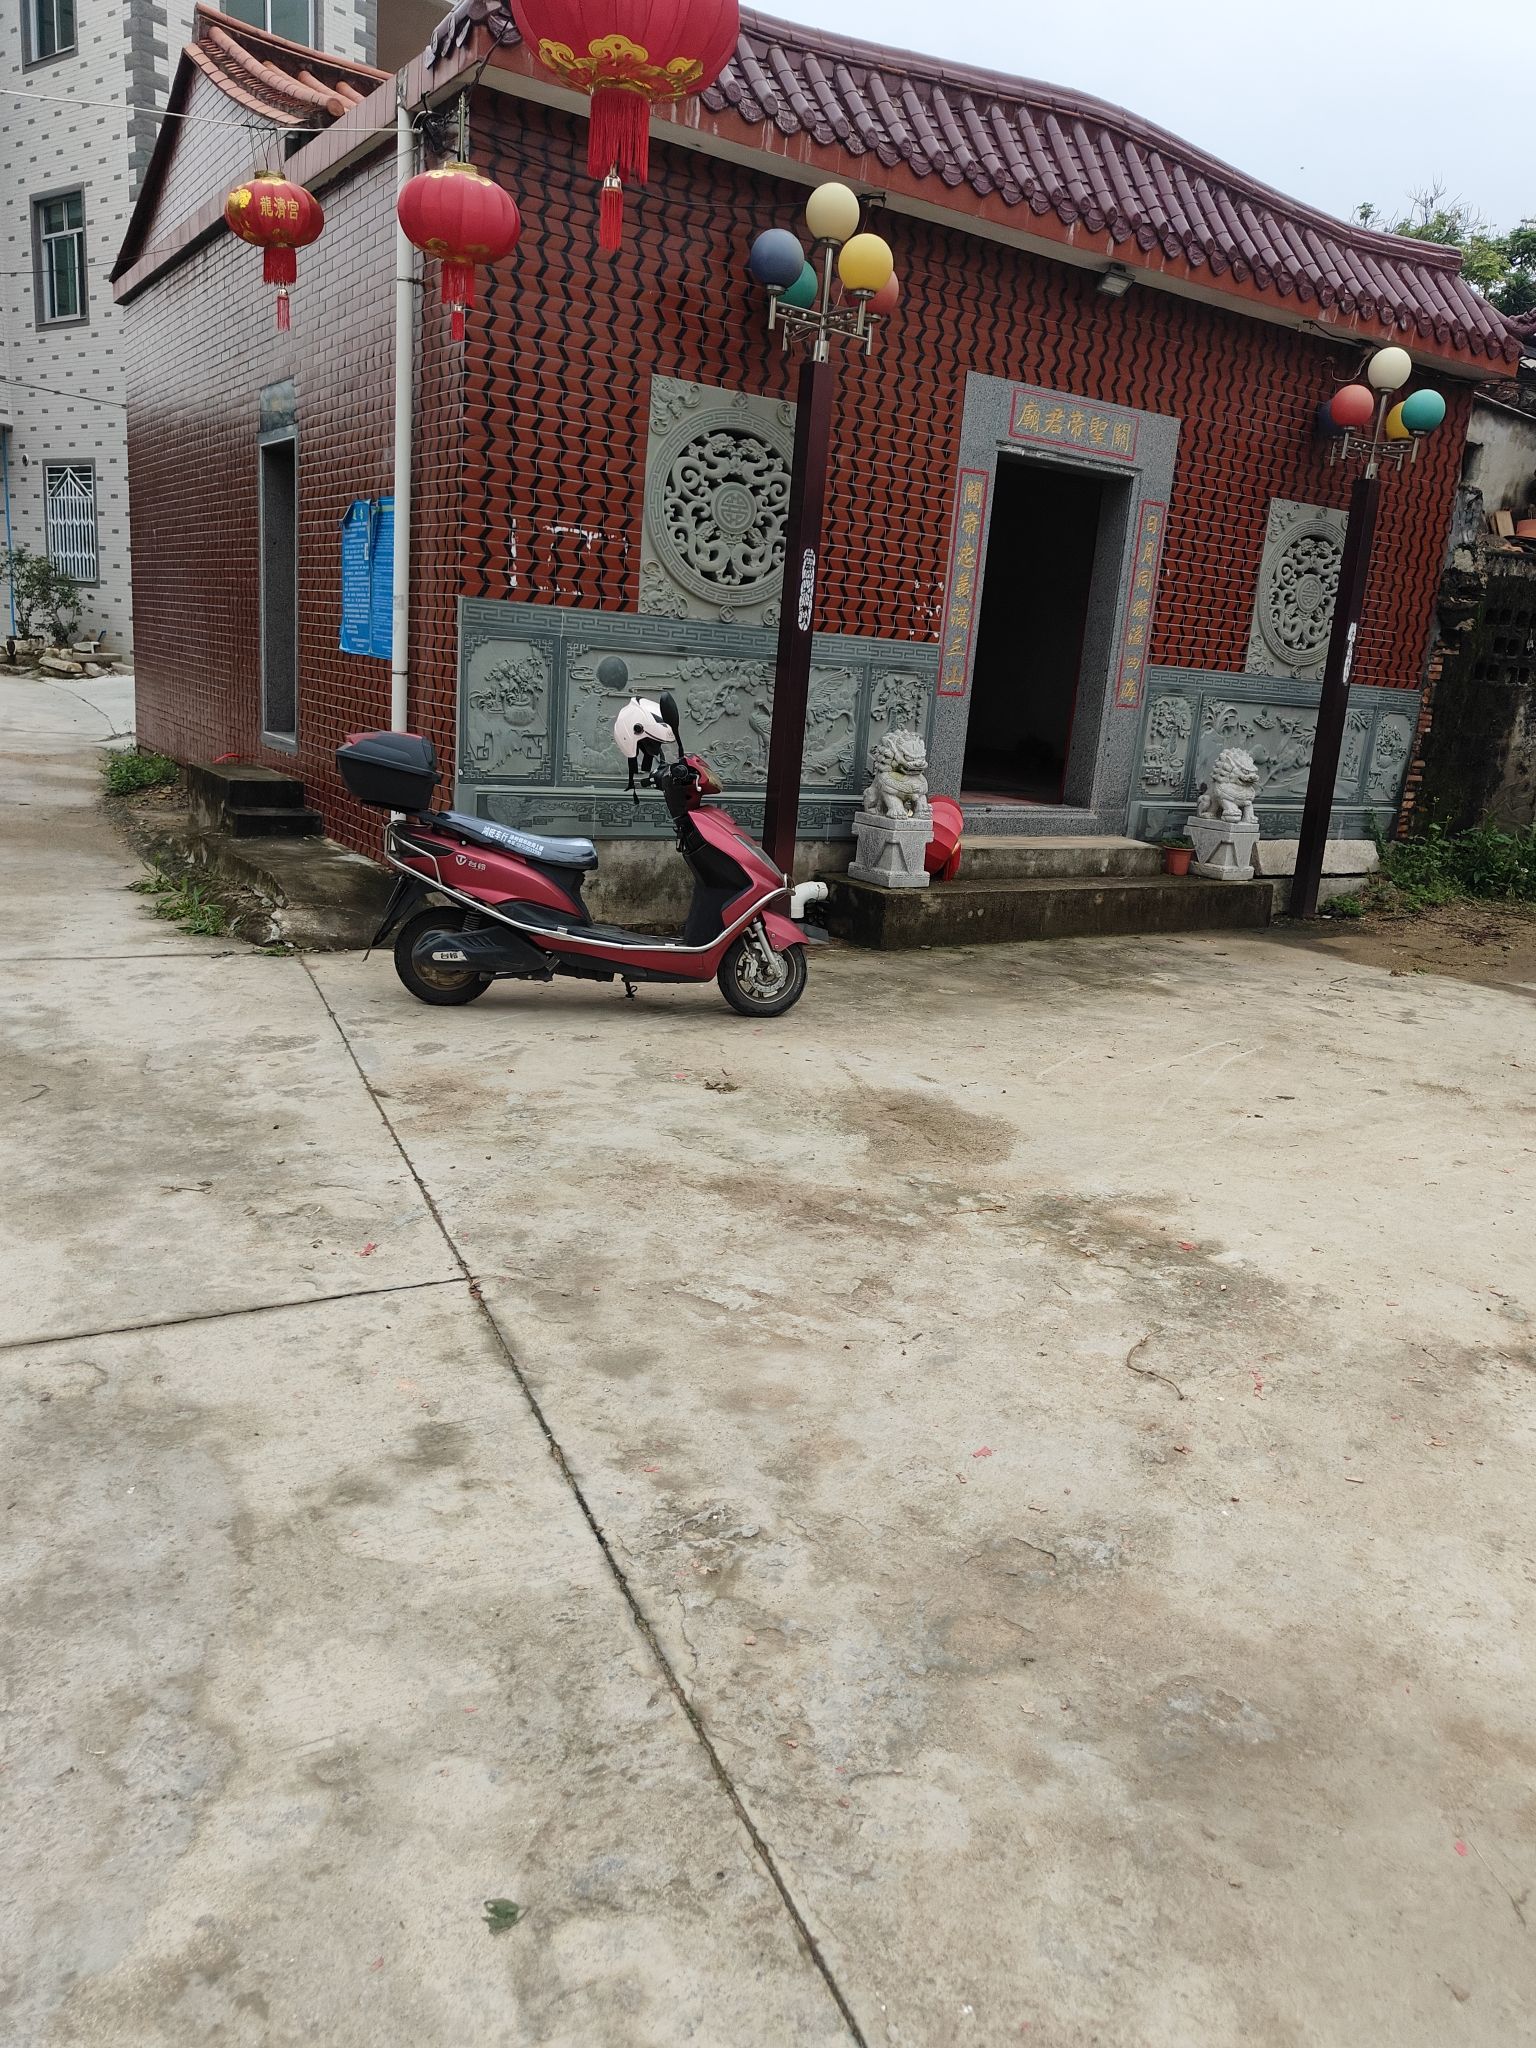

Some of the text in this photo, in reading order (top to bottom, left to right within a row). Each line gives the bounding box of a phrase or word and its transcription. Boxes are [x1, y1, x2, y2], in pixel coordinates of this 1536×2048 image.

[1016, 399, 1132, 452] 關聖帝君廟
